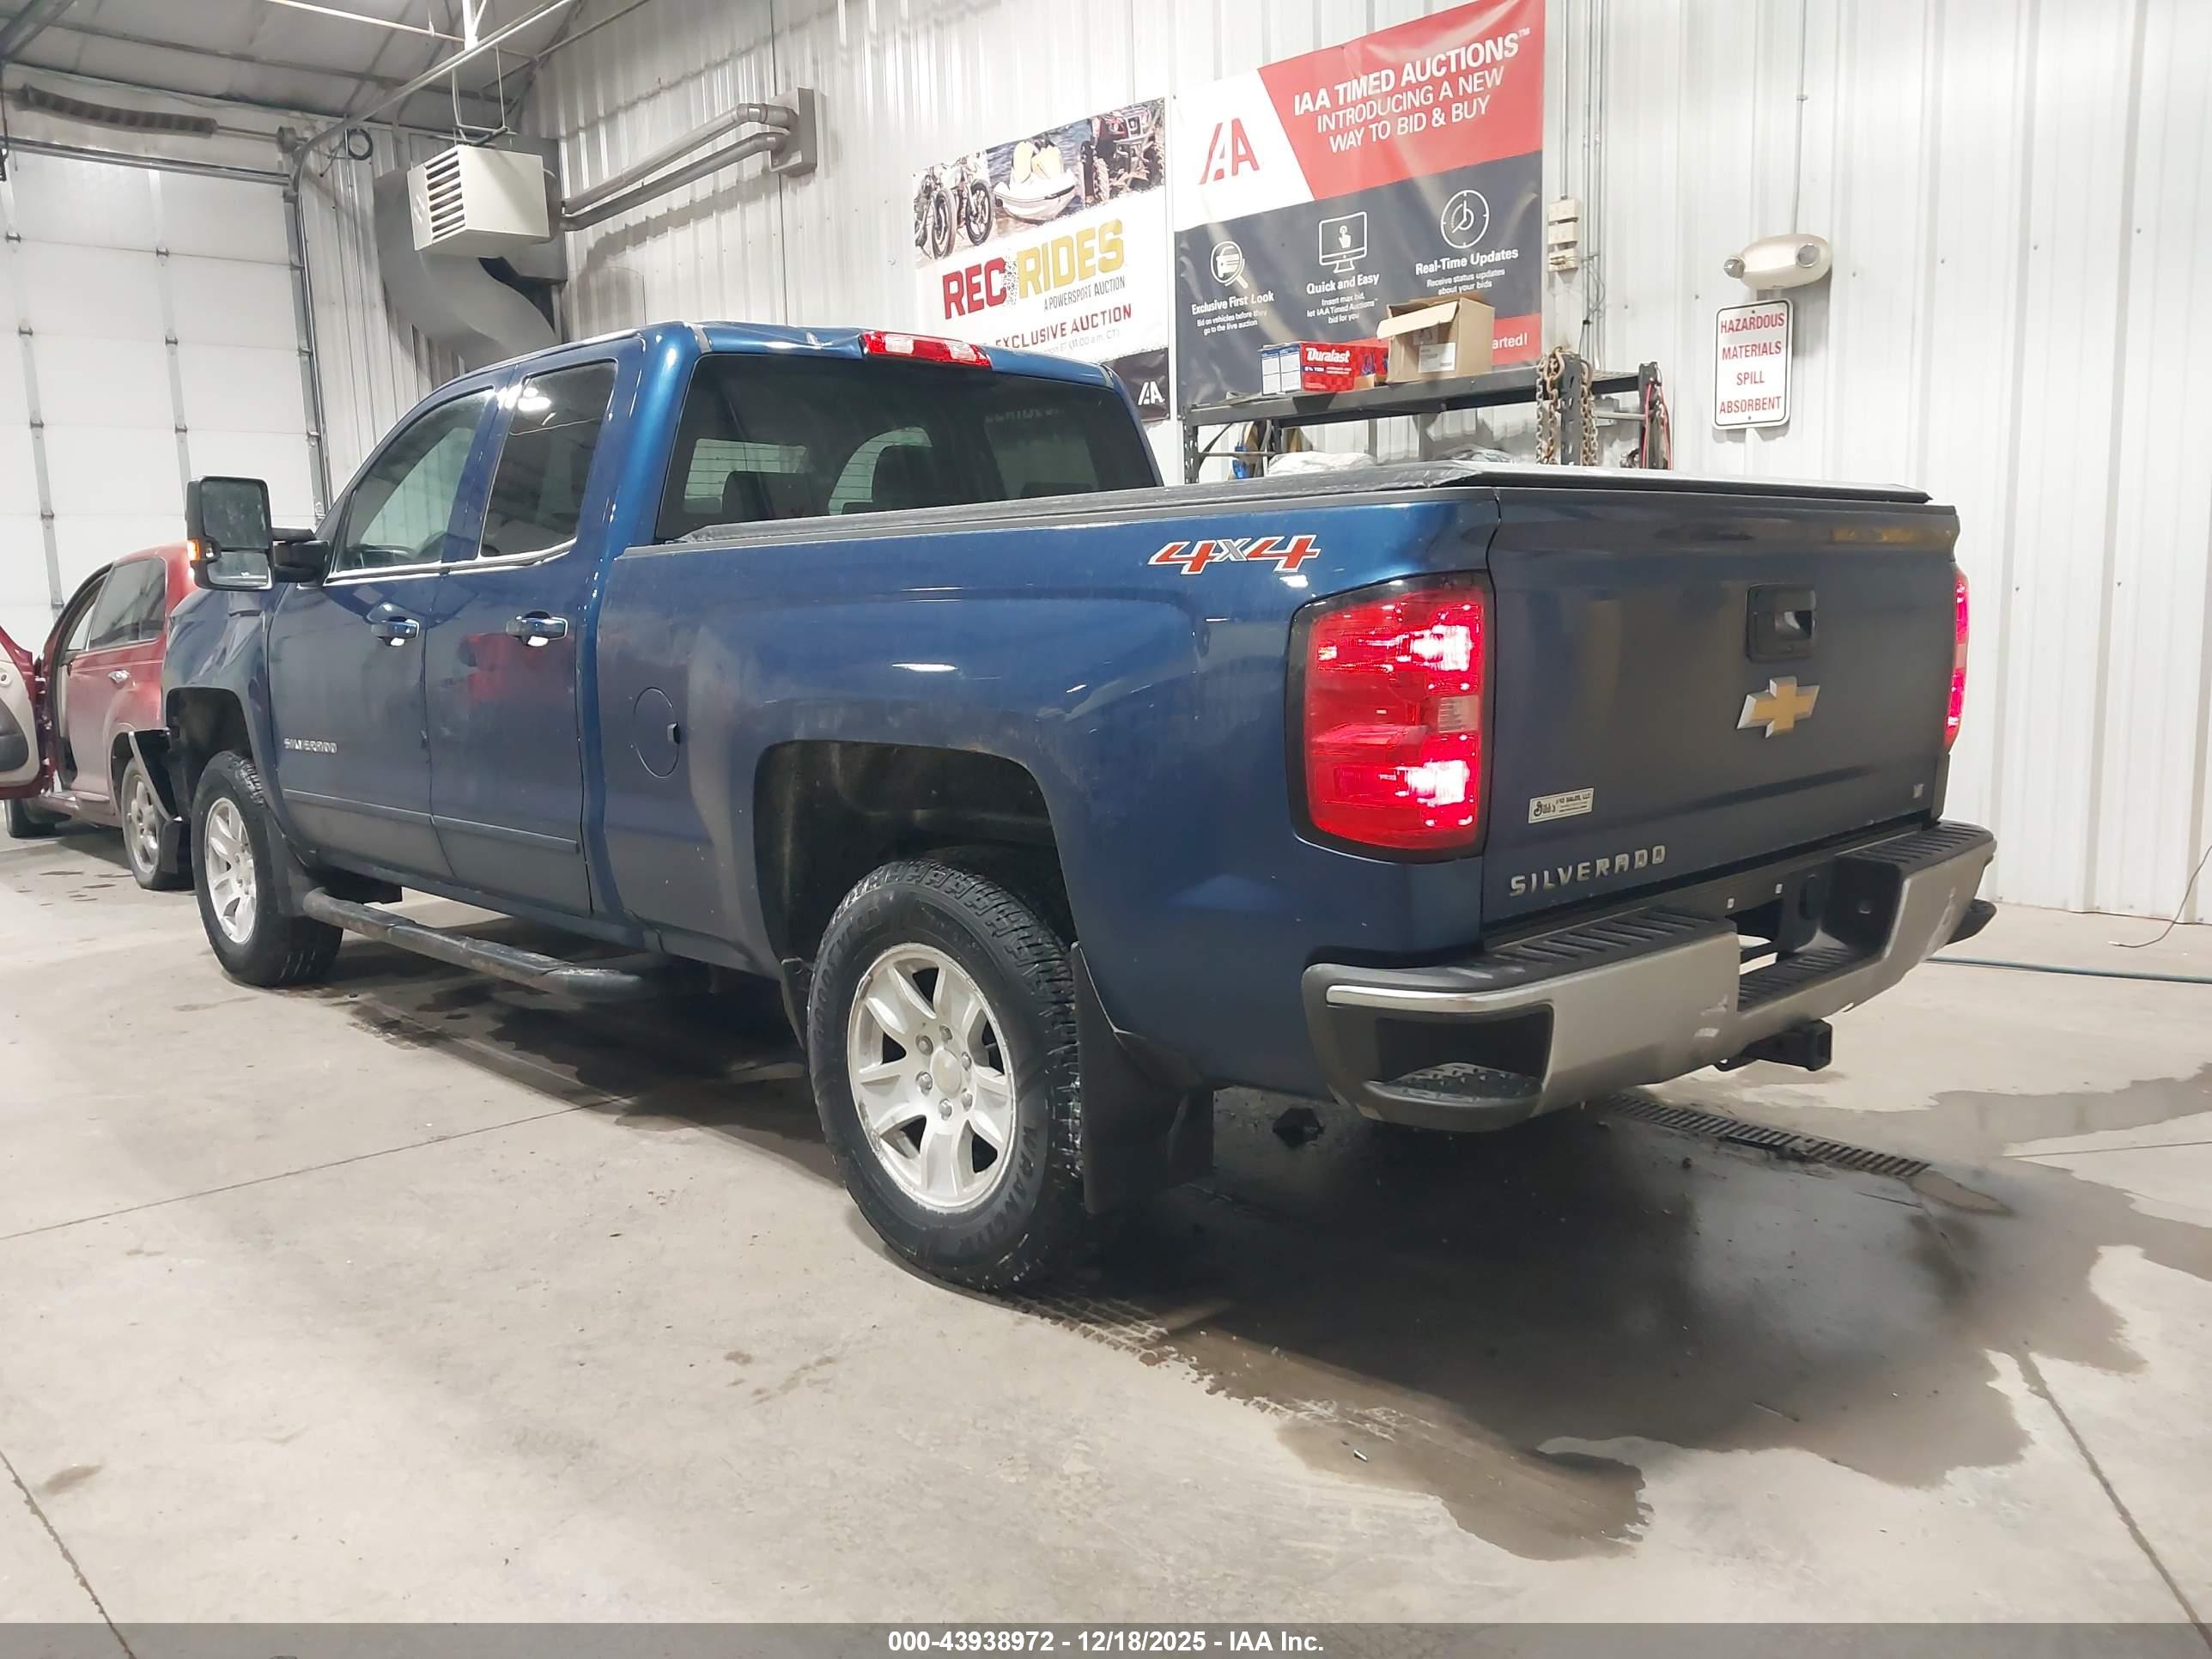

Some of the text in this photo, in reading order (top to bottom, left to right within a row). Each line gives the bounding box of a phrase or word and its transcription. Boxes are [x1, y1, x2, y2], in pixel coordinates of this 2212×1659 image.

[1294, 90, 1331, 117] IAA
[1334, 68, 1396, 106] TIMED
[1317, 65, 1504, 134] INTRODUCING A NEW
[1329, 94, 1491, 154] WAY TO BID & BUY
[942, 219, 1125, 319] REC RIDES
[1415, 249, 1519, 275] Real-Time Updates
[1044, 275, 1125, 312] A POWERSPORT AUCTION
[1306, 273, 1380, 295] Quick and Easy
[1191, 290, 1274, 315] Exclusive First Look
[1316, 307, 1330, 316] IAA
[995, 303, 1132, 348] EXCLUSIVE AUCTION
[1720, 313, 1785, 334] HAZARDOUS
[1492, 332, 1528, 349] arted!
[1722, 341, 1782, 361] MATERIALS
[1305, 347, 1351, 363] Duralast
[1736, 370, 1765, 386] SPILL
[1719, 396, 1782, 415] ABSORBENT
[1509, 844, 1666, 896] SILVERADO
